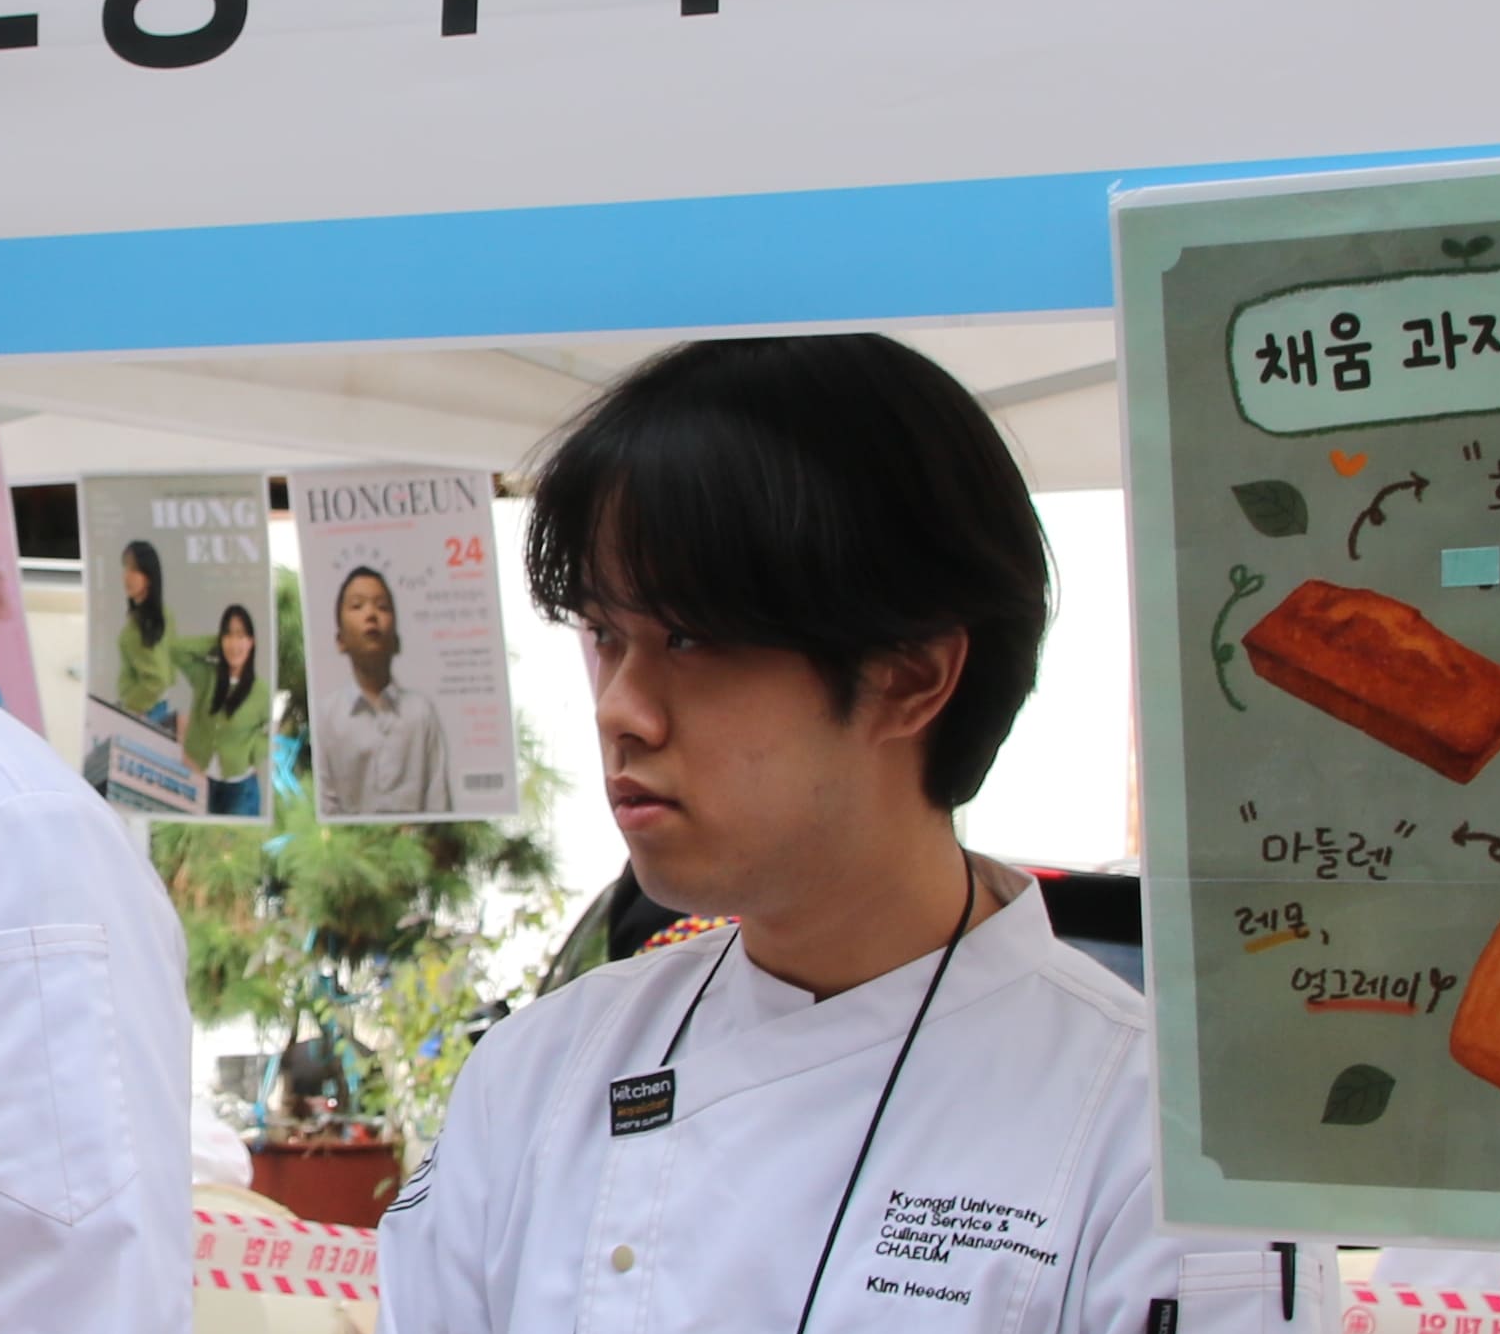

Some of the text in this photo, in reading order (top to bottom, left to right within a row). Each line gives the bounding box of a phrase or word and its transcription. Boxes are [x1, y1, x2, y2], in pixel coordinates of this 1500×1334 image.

[1255, 312, 1373, 391] 채움
[152, 496, 258, 529] HONG
[307, 476, 477, 524] HONGEUN
[186, 533, 260, 564] EUN
[445, 535, 486, 566] 24
[612, 1080, 672, 1102] kitchen
[884, 1208, 1009, 1232] Food Service &
[889, 1190, 1048, 1229] Kyonggi University
[875, 1241, 950, 1264] CHAEUM
[880, 1224, 1059, 1267] Culinary Management
[866, 1275, 972, 1306] Kim Heedong
